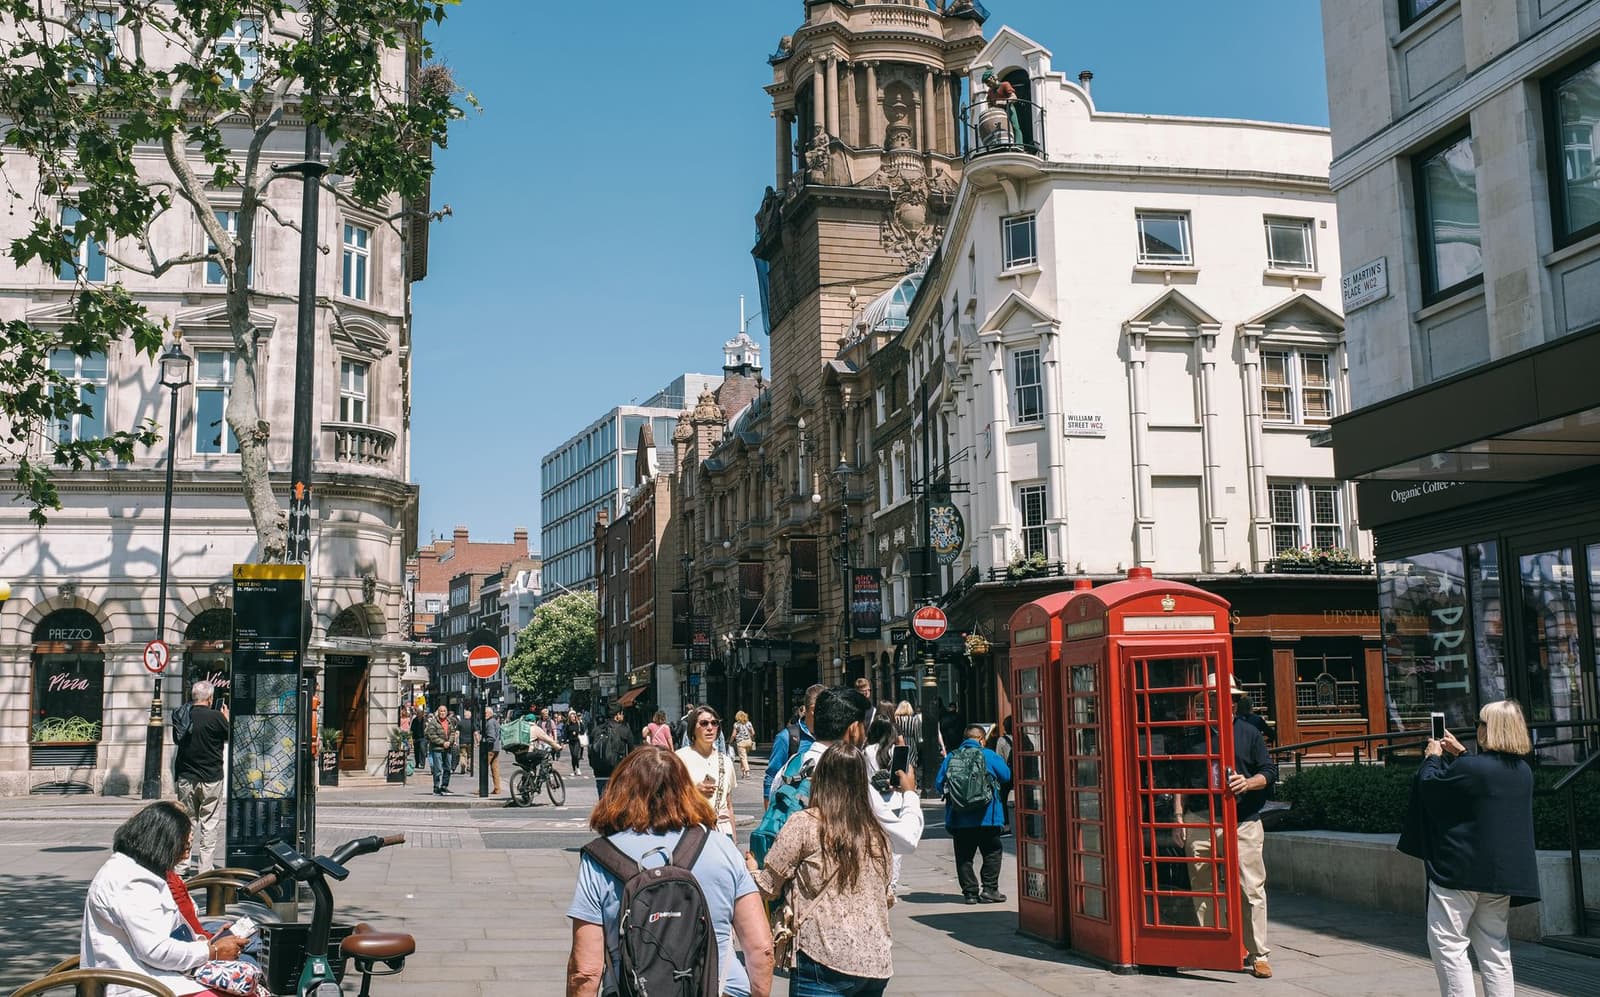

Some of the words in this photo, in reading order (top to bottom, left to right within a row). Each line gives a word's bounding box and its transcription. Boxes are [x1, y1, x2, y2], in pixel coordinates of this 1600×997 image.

[1343, 277, 1351, 289] ST.
[1352, 263, 1382, 284] MARTIN'S
[1344, 284, 1361, 300] PLACE
[1363, 277, 1377, 291] WC2
[1067, 421, 1089, 429] STREET
[1391, 484, 1421, 503] Organic
[1323, 609, 1380, 625] UPSTAI
[49, 628, 93, 640] PREZZO
[1432, 606, 1470, 694] PRET
[48, 672, 90, 692] Pizza
